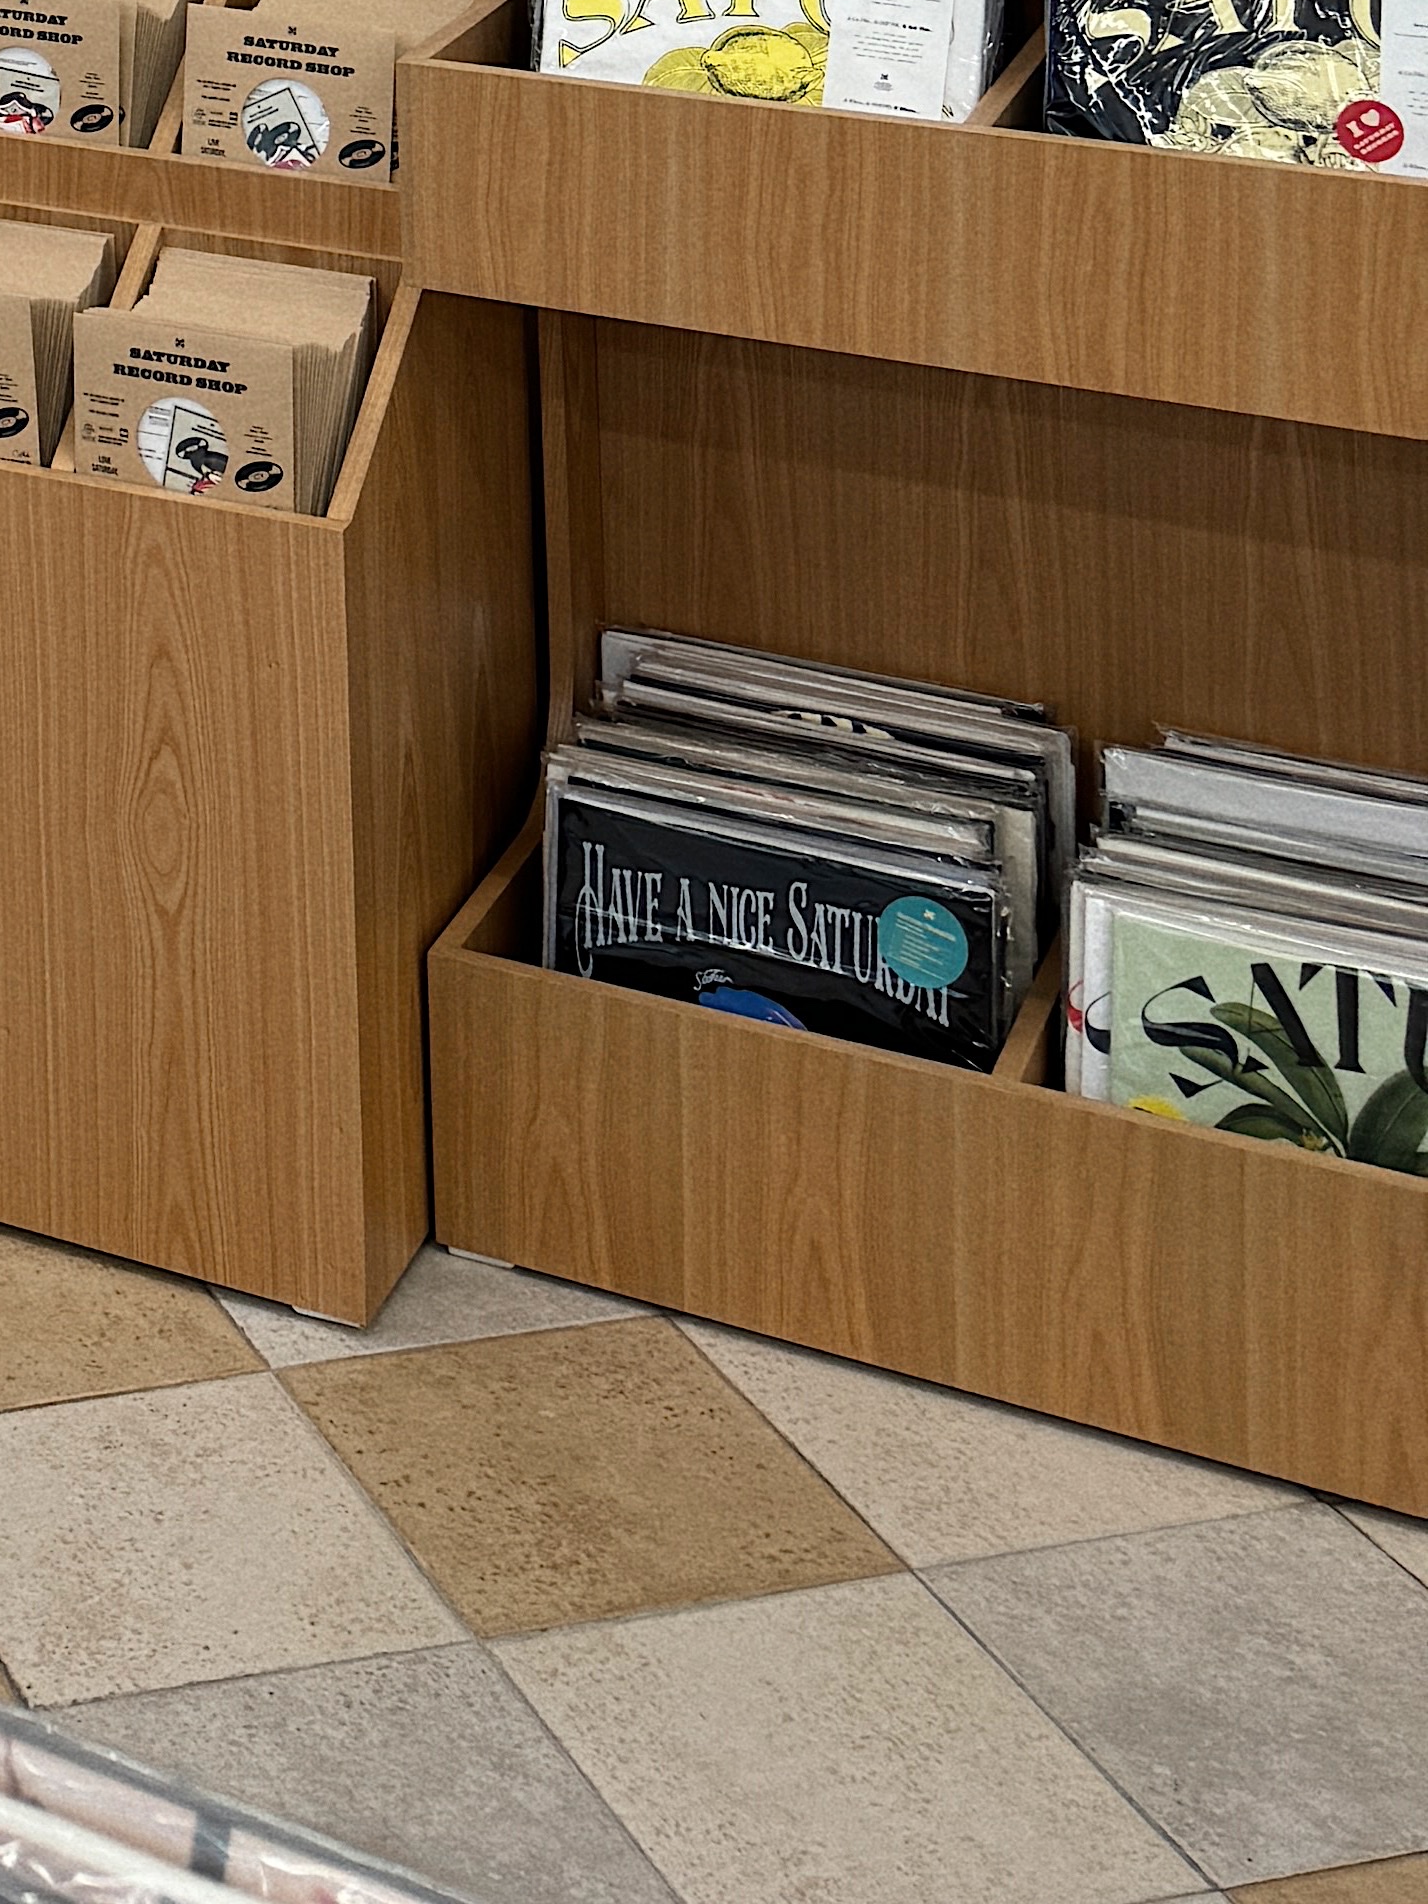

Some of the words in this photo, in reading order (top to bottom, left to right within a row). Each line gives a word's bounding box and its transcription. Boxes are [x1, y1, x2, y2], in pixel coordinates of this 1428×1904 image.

[36, 30, 84, 45] SHOP
[243, 35, 339, 58] SATURDAY
[226, 51, 302, 72] RECORD
[304, 62, 356, 78] SHOP
[128, 347, 230, 373] SATURDAY
[112, 363, 193, 389] RECORD
[195, 377, 248, 395] SHOP
[575, 842, 663, 979] HAVE
[675, 877, 695, 942] A
[707, 881, 775, 951] NICE
